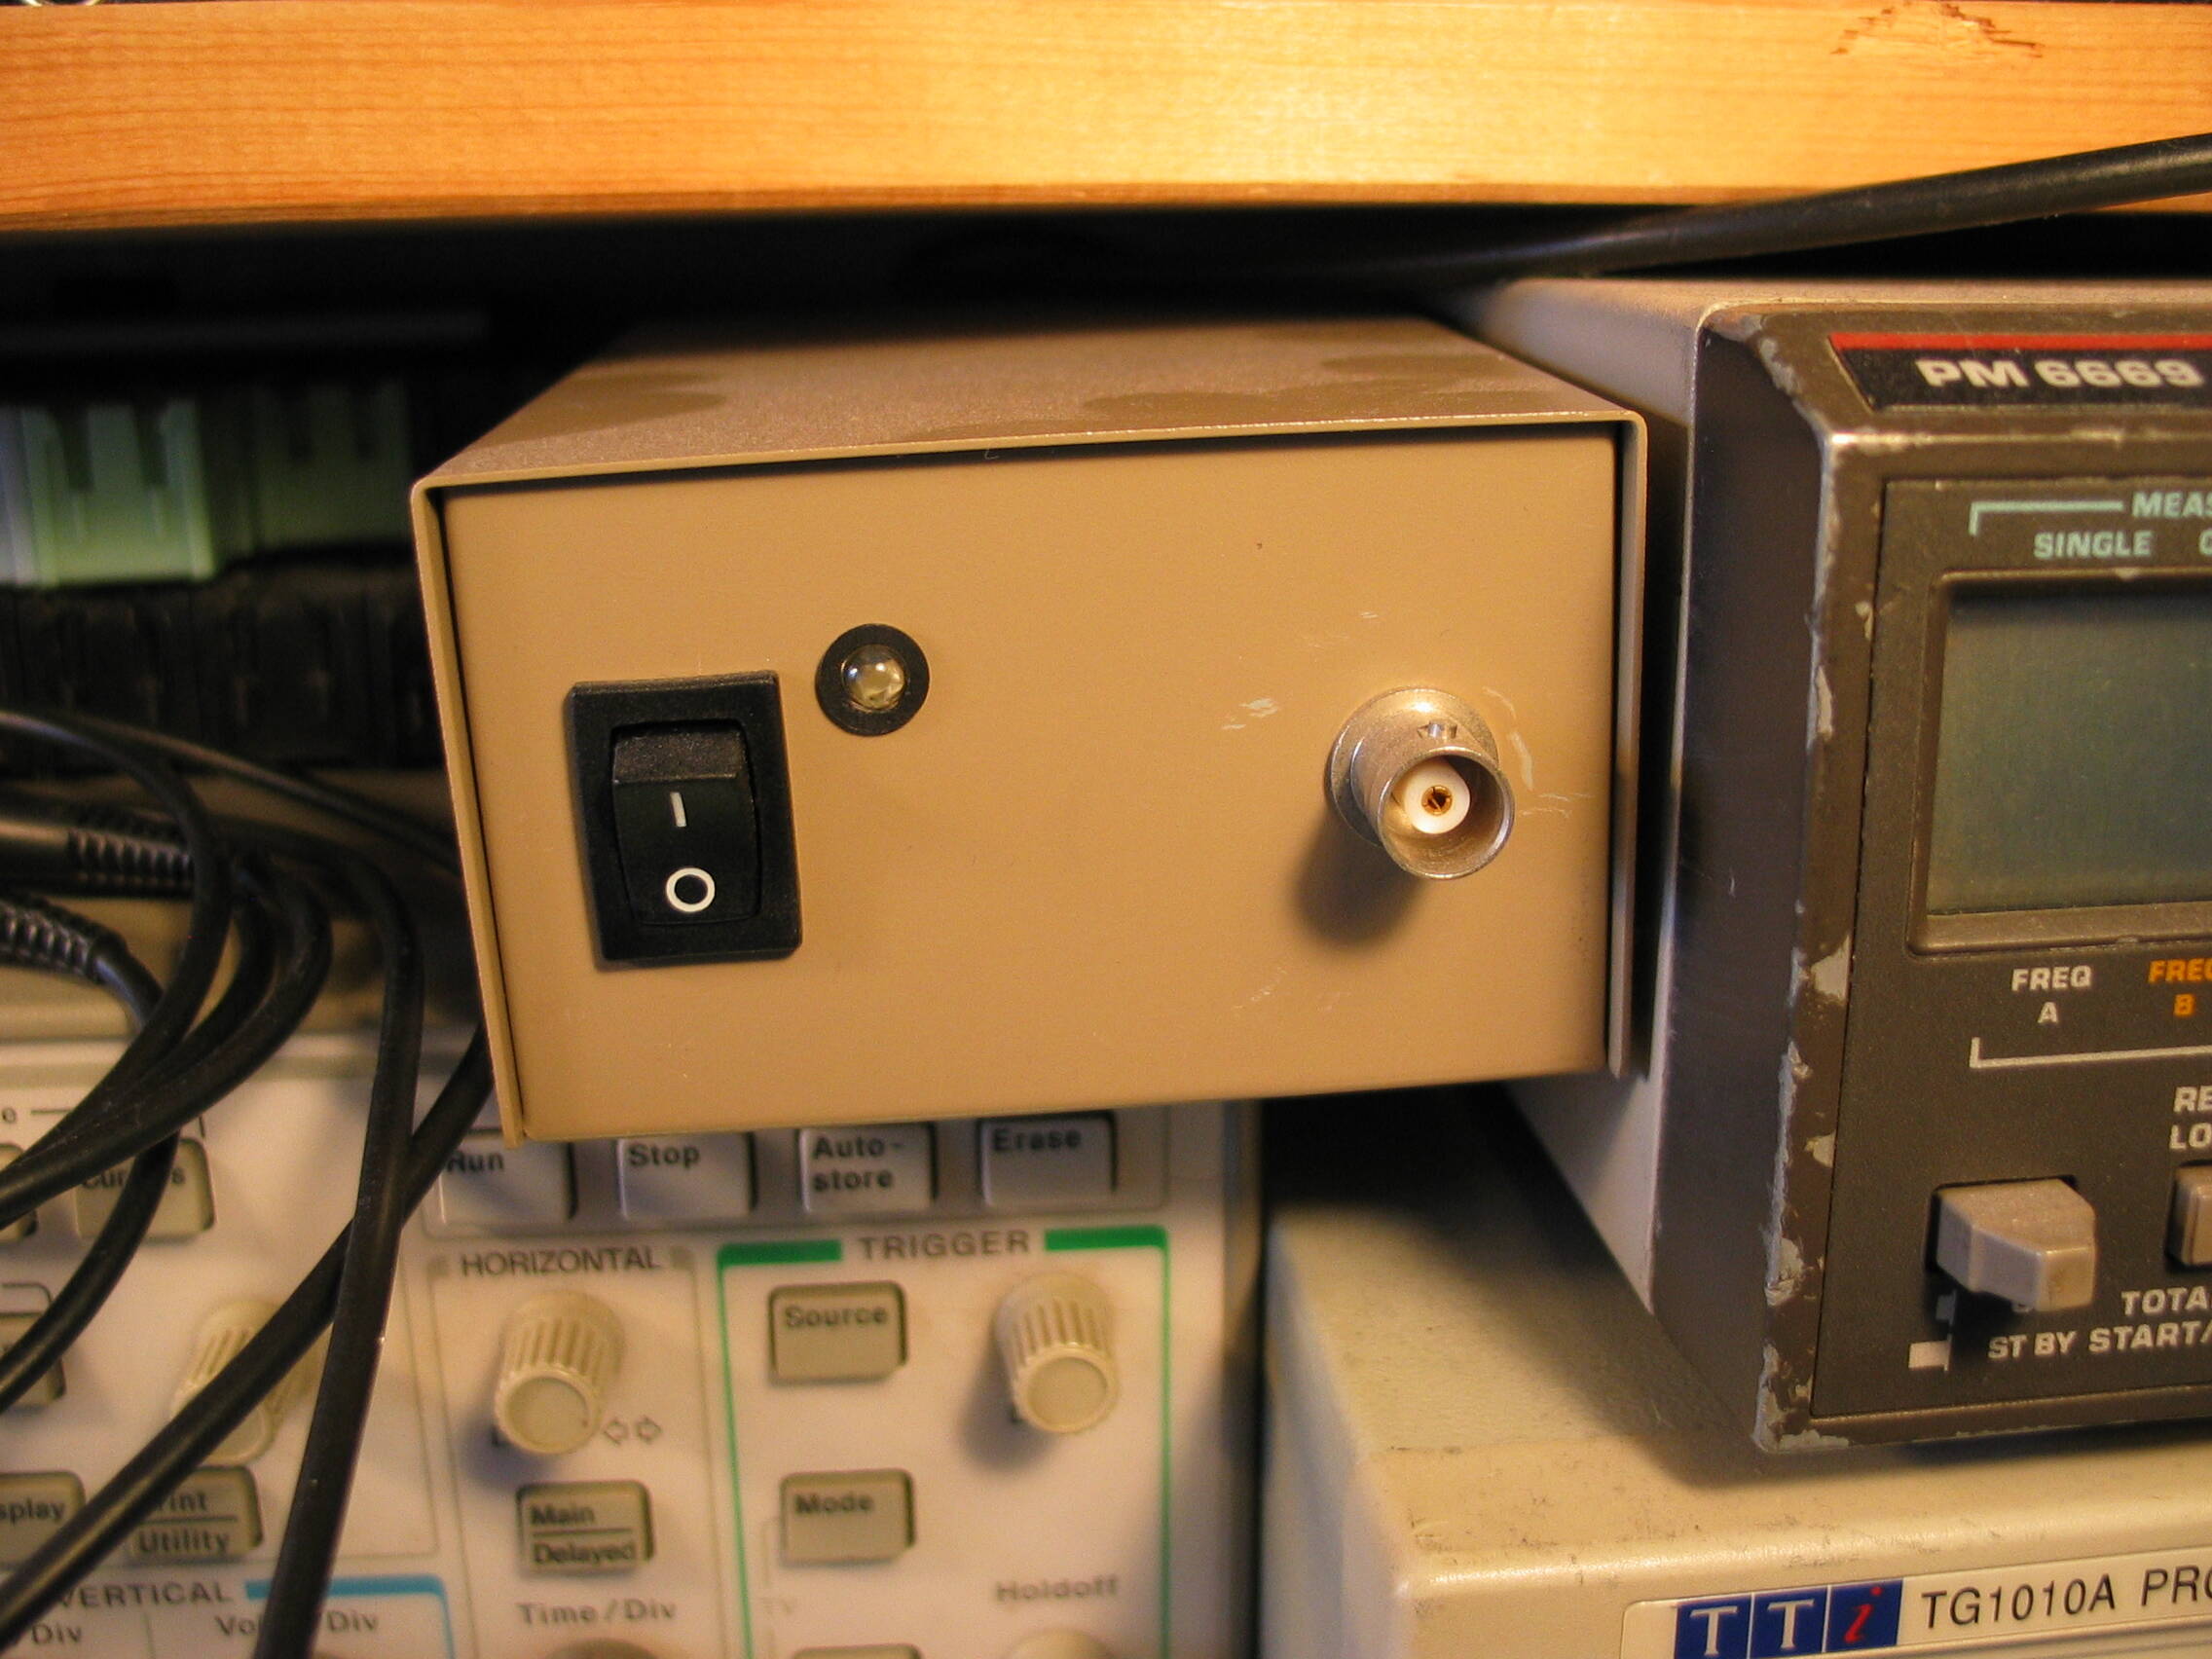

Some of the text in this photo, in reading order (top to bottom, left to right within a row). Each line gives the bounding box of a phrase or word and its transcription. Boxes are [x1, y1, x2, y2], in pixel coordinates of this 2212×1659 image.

[1915, 359, 2203, 387] PM 6669
[2034, 531, 2154, 560] SINGLE
[2011, 965, 2092, 991] FREQ
[2038, 1002, 2059, 1023] A
[2173, 994, 2195, 1017] B
[992, 1127, 1083, 1153] Erase
[628, 1143, 701, 1170] Stop
[813, 1169, 896, 1193] store
[858, 1230, 1030, 1260] TRIGGER
[461, 1246, 662, 1276] HORIZONTAL
[2120, 1286, 2212, 1315] TOTA
[785, 1306, 888, 1330] Source
[1988, 1335, 2027, 1359] ST
[2033, 1331, 2078, 1357] BY
[531, 1504, 596, 1526] Main
[793, 1493, 874, 1515] Mode
[137, 1529, 230, 1555] Utility
[534, 1541, 635, 1565] Delayed
[60, 1581, 233, 1608] VERTICAL
[996, 1574, 1119, 1603] Holdoff
[1922, 1574, 2116, 1628] TG1010A
